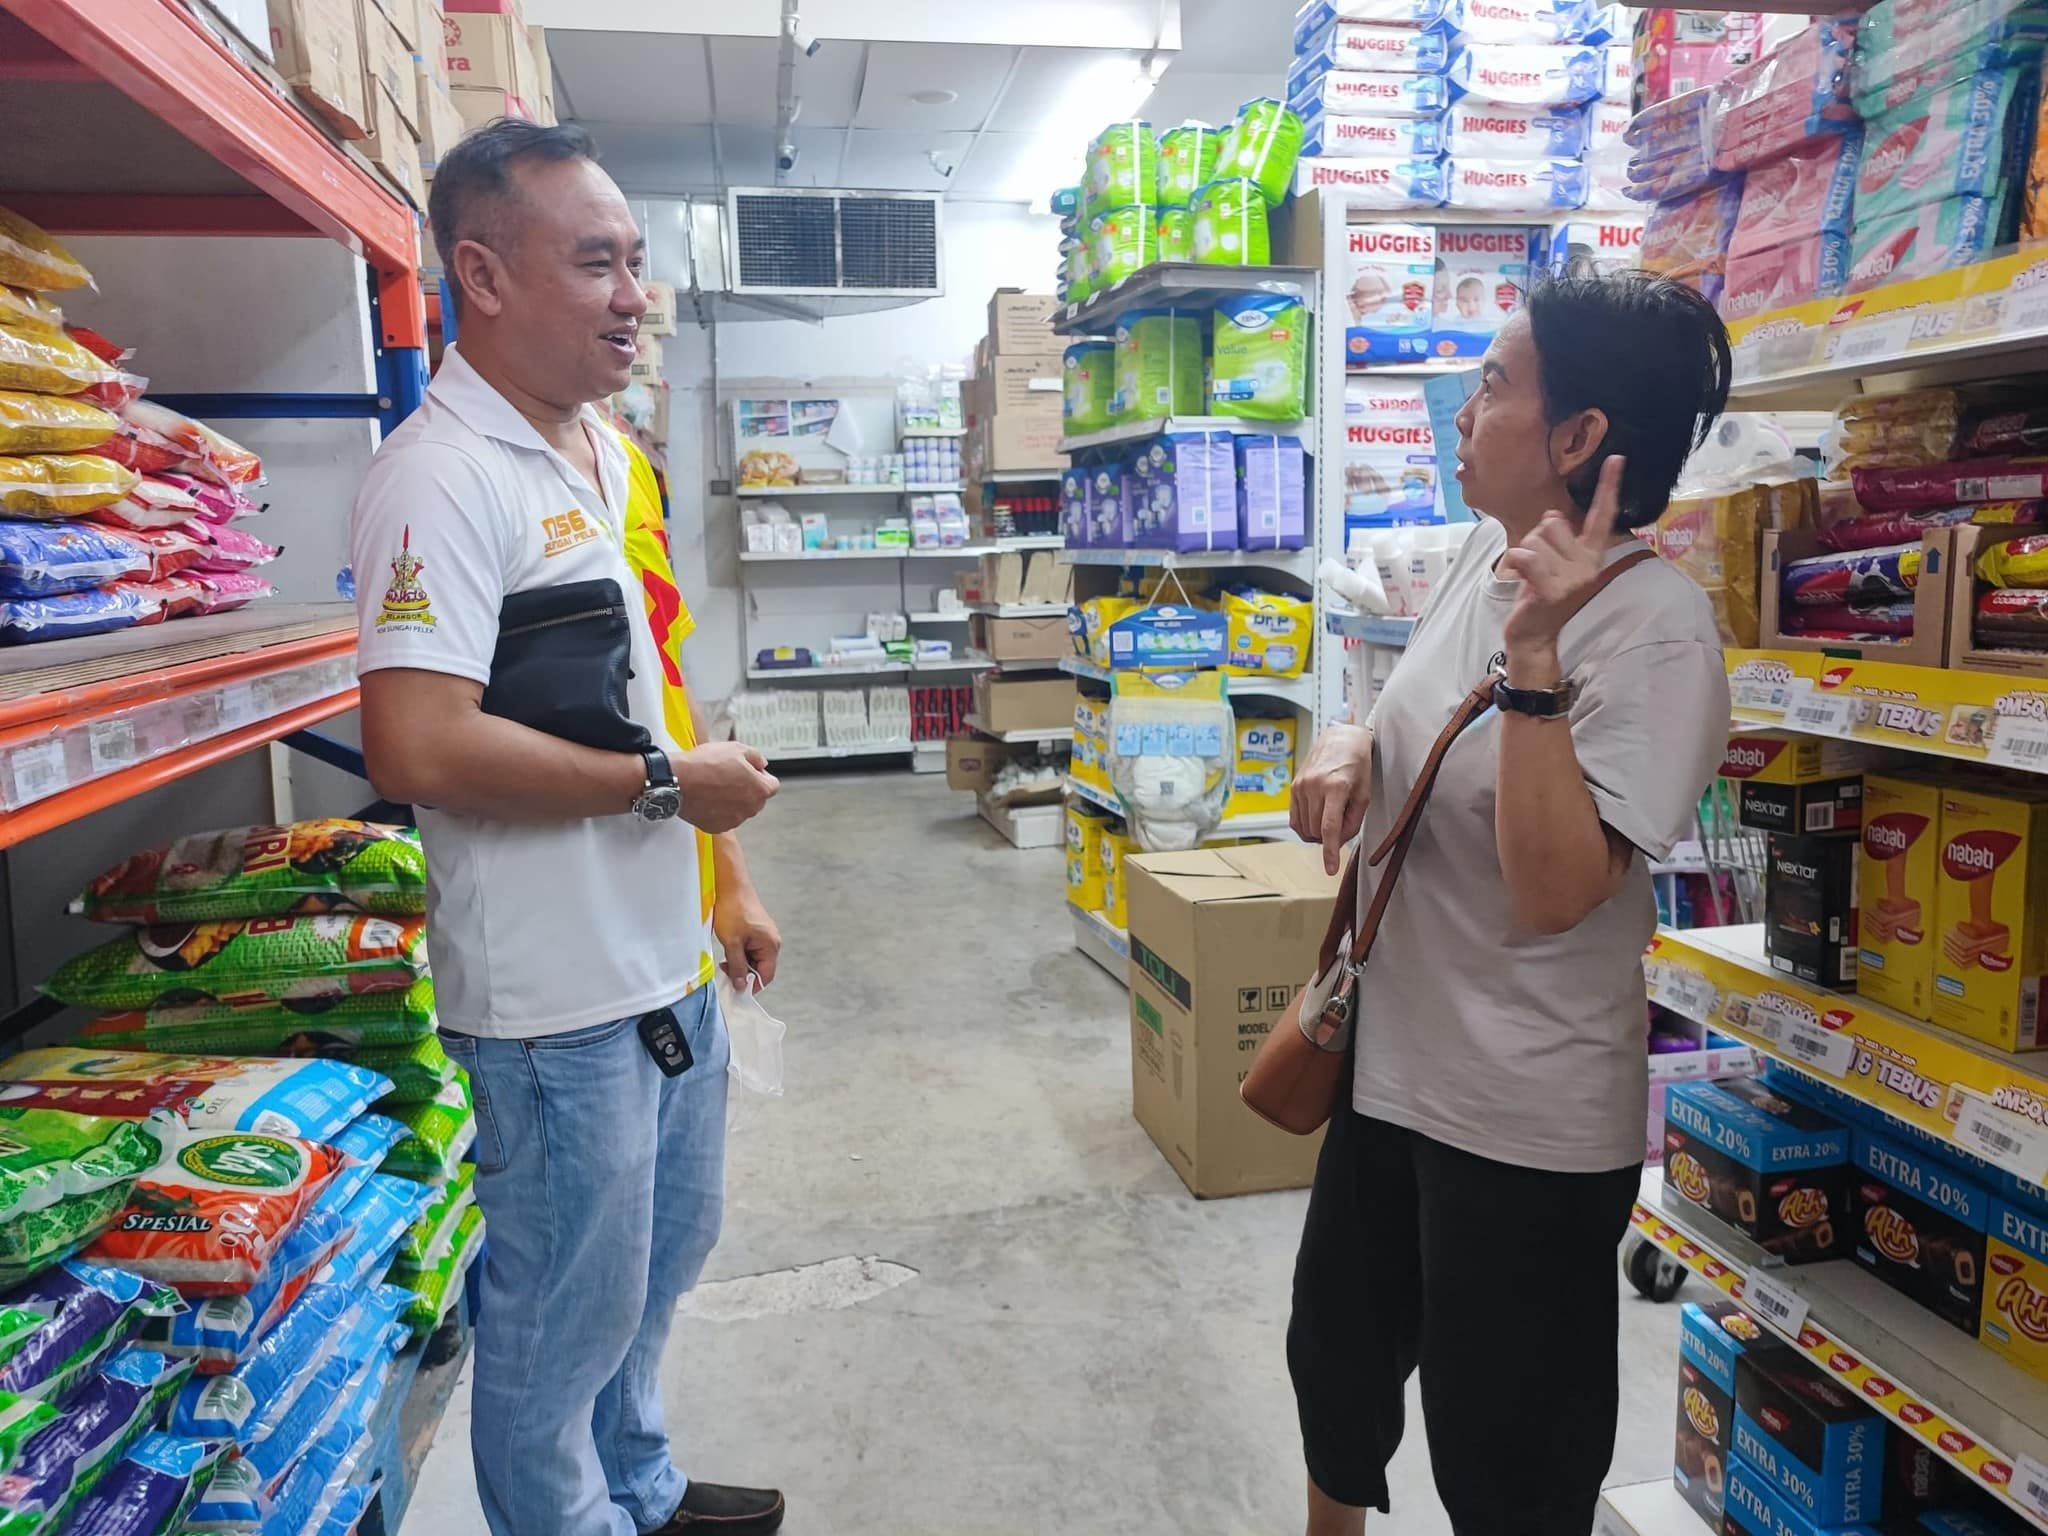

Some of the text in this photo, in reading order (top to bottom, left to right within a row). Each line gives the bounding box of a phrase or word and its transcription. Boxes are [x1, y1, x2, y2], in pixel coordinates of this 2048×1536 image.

[1346, 36, 1405, 52] HUGGIES
[1336, 124, 1396, 141] HUGGIES
[1462, 117, 1527, 134] HUGGIES
[1312, 168, 1390, 185] HUGGIES
[1463, 171, 1527, 187] HUGGIES
[1349, 234, 1432, 253] HUGGIES
[1439, 233, 1525, 252] HUGGIES
[1912, 312, 1957, 340] BUS
[1346, 426, 1432, 444] HUGGIES
[1877, 702, 1945, 736] TEBUS
[1995, 697, 2048, 723] RM50,
[1272, 731, 1285, 745] P
[1867, 824, 1906, 849] nabati
[1947, 843, 1995, 870] nabati
[1238, 1039, 1257, 1051] QTY
[1877, 1059, 1942, 1109] TEBUS
[1671, 1096, 1750, 1159] EXTRA 20%
[1772, 1143, 1841, 1161] EXTRA 20%
[1869, 1145, 1921, 1192] EXTRA
[1928, 1175, 1970, 1217] 20%
[123, 1214, 212, 1232] SPESIAL
[1681, 1325, 1729, 1379] EXTRA 20%
[1737, 1425, 1814, 1509] EXTRA 30%
[1844, 1424, 1865, 1523] EXTRA 30%
[1730, 1475, 1772, 1529] EXTRA
